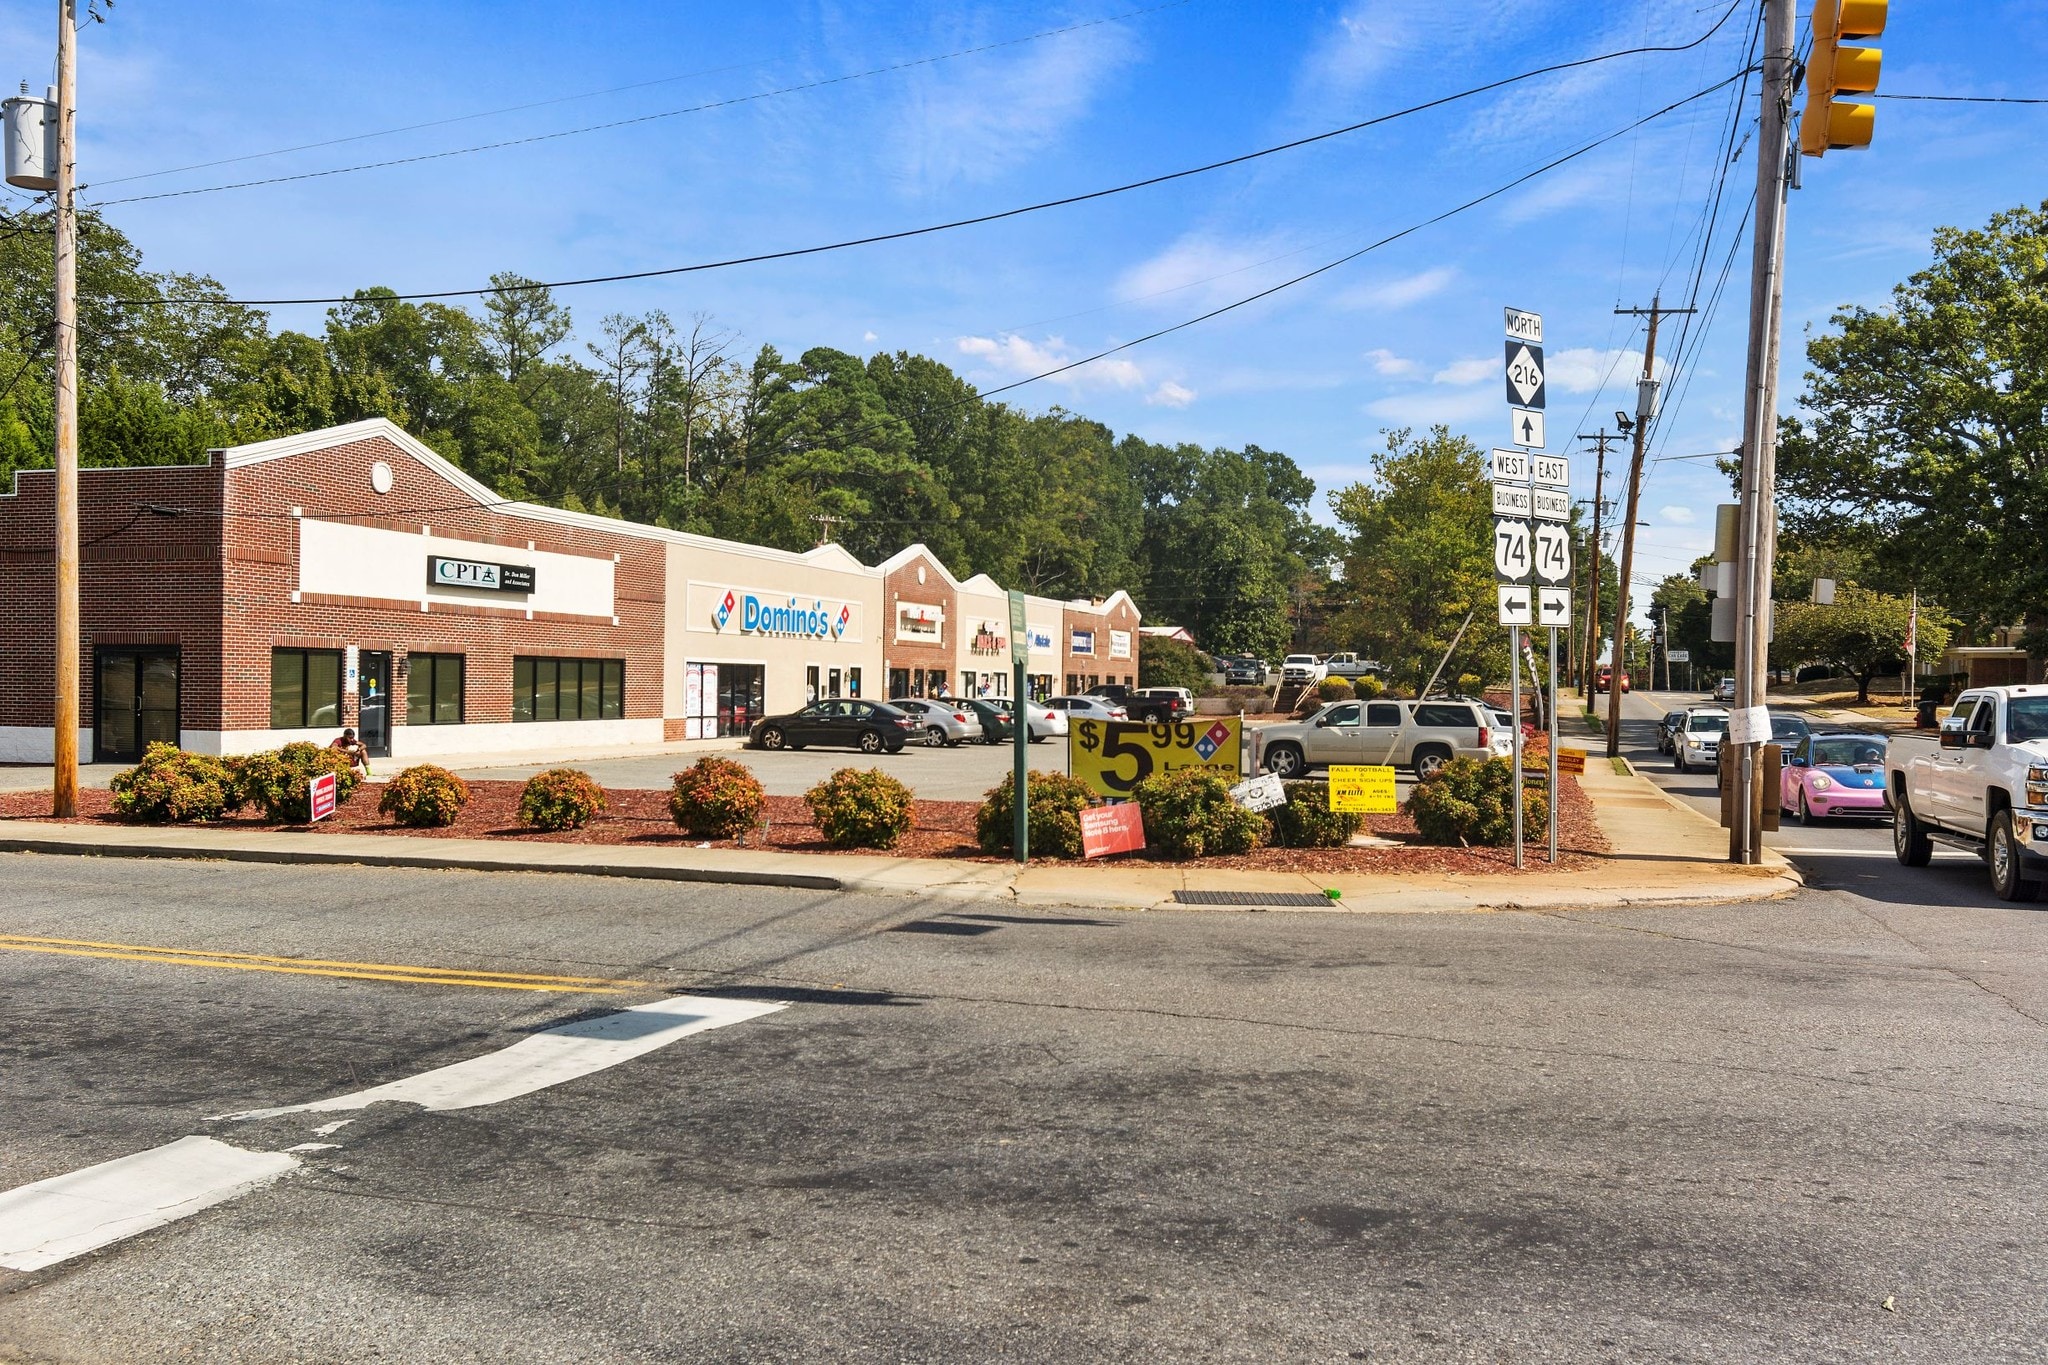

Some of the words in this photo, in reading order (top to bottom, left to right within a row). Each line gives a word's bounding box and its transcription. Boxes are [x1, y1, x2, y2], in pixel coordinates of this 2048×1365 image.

[1507, 313, 1541, 337] NORTH
[1514, 364, 1538, 387] 216
[1497, 455, 1525, 476] WEST
[1539, 461, 1564, 481] EAST
[1496, 490, 1528, 509] BUSINESS
[1537, 495, 1567, 513] BUSINESS
[1499, 532, 1526, 568] 74
[1539, 536, 1565, 570] 74
[741, 594, 829, 636] Domino's
[1083, 813, 1095, 823] Get
[1095, 811, 1113, 821] your
[1084, 818, 1118, 830] Samsung
[1085, 827, 1103, 838] Note
